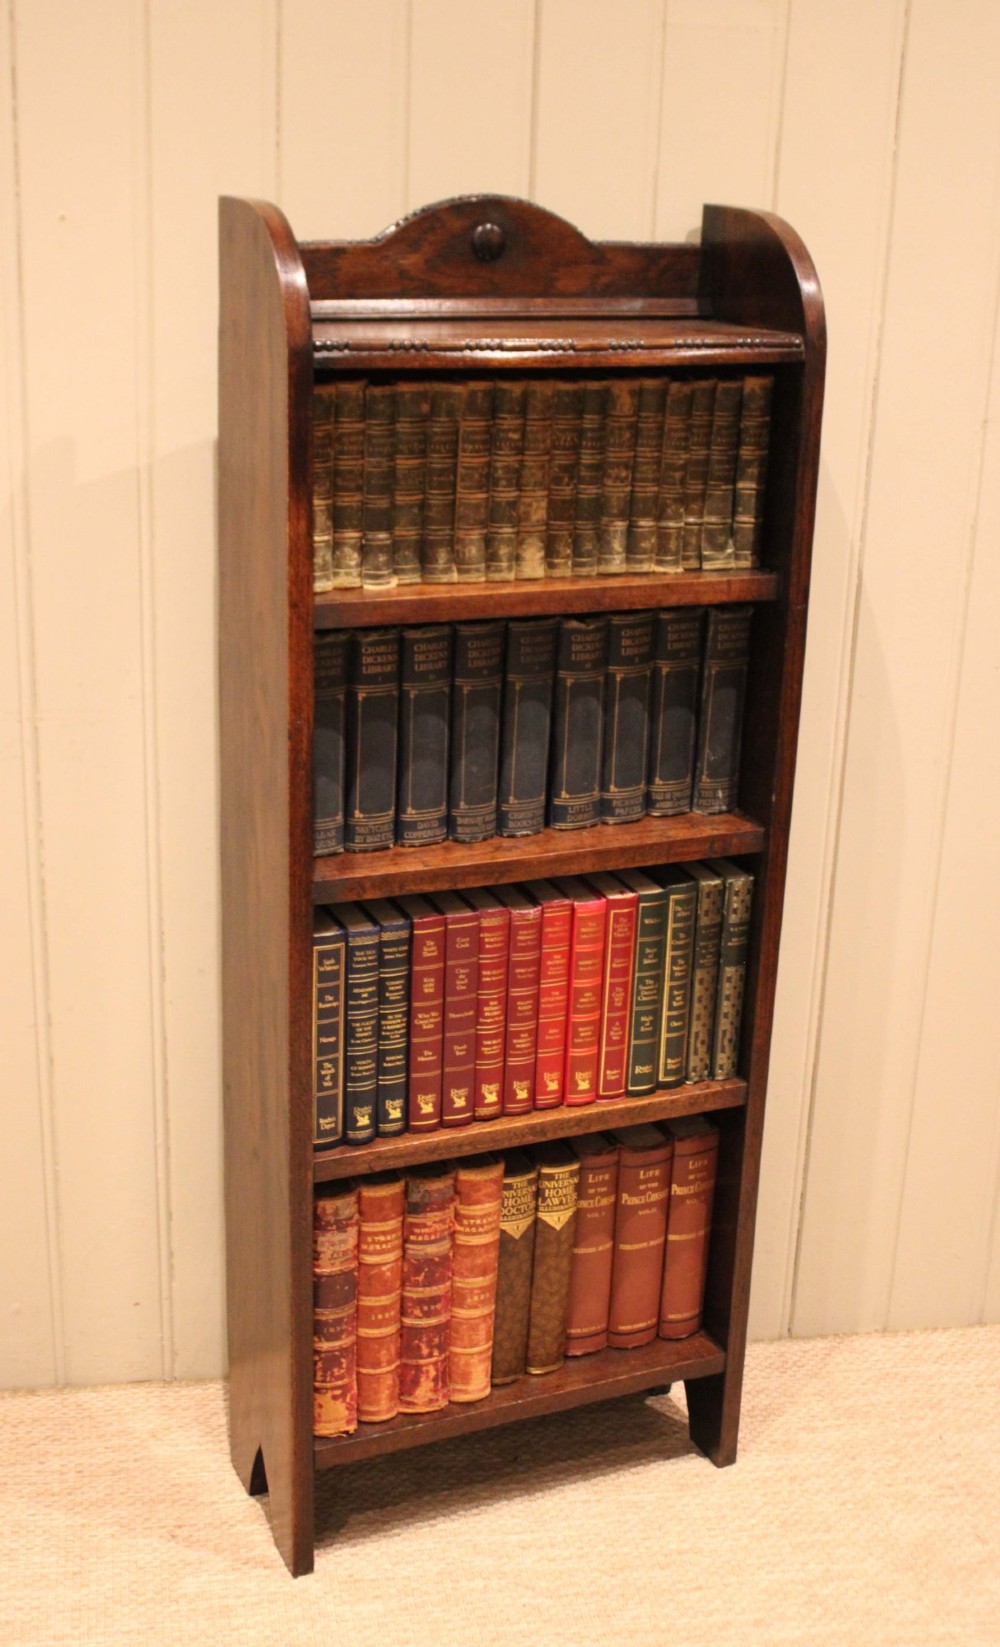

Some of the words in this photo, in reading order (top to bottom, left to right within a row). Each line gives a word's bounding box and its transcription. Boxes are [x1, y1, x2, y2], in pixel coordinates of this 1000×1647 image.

[554, 1172, 571, 1181] THE
[639, 1169, 661, 1180] LIFE
[512, 1181, 529, 1190] THE
[545, 1185, 574, 1198] HOME
[503, 1193, 533, 1208] HOME
